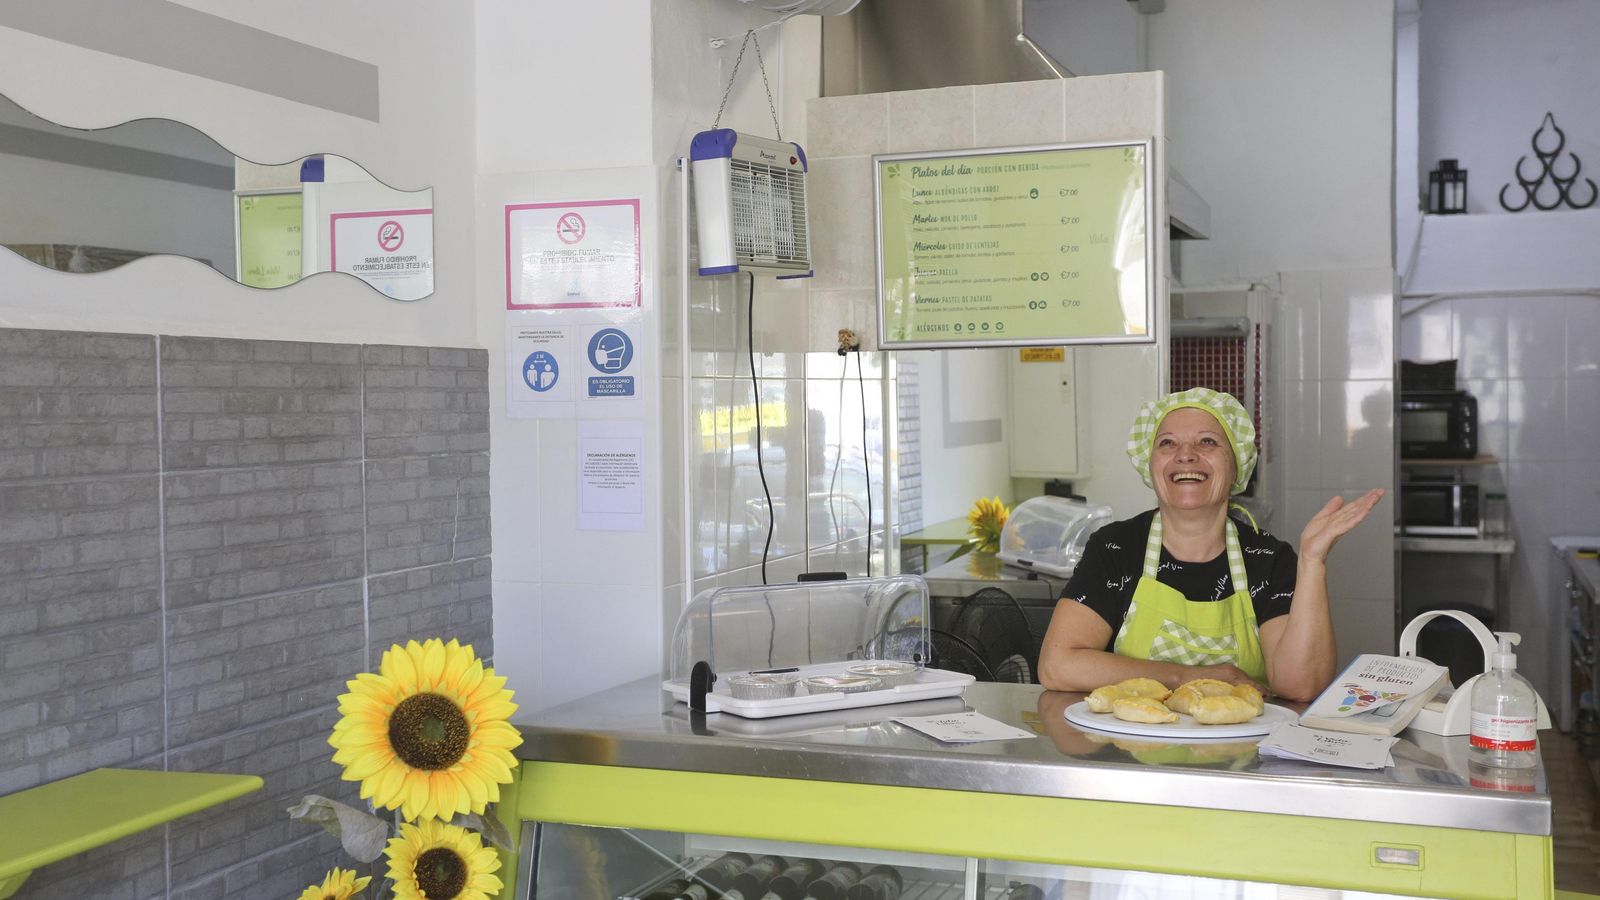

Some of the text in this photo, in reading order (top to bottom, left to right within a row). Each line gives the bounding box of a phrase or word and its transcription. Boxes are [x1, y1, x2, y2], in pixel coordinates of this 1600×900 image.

[911, 165, 940, 179] Platos
[941, 164, 957, 176] del
[912, 188, 933, 198] Lunes
[982, 184, 999, 193] ARROZ
[912, 214, 939, 224] Martes
[1060, 216, 1080, 225] €7.00
[1060, 244, 1080, 253] €7.00
[1060, 271, 1080, 280] €7.00
[914, 294, 941, 305] Viernes
[1062, 299, 1081, 308] €7.00
[1358, 672, 1414, 686] sin gluten
